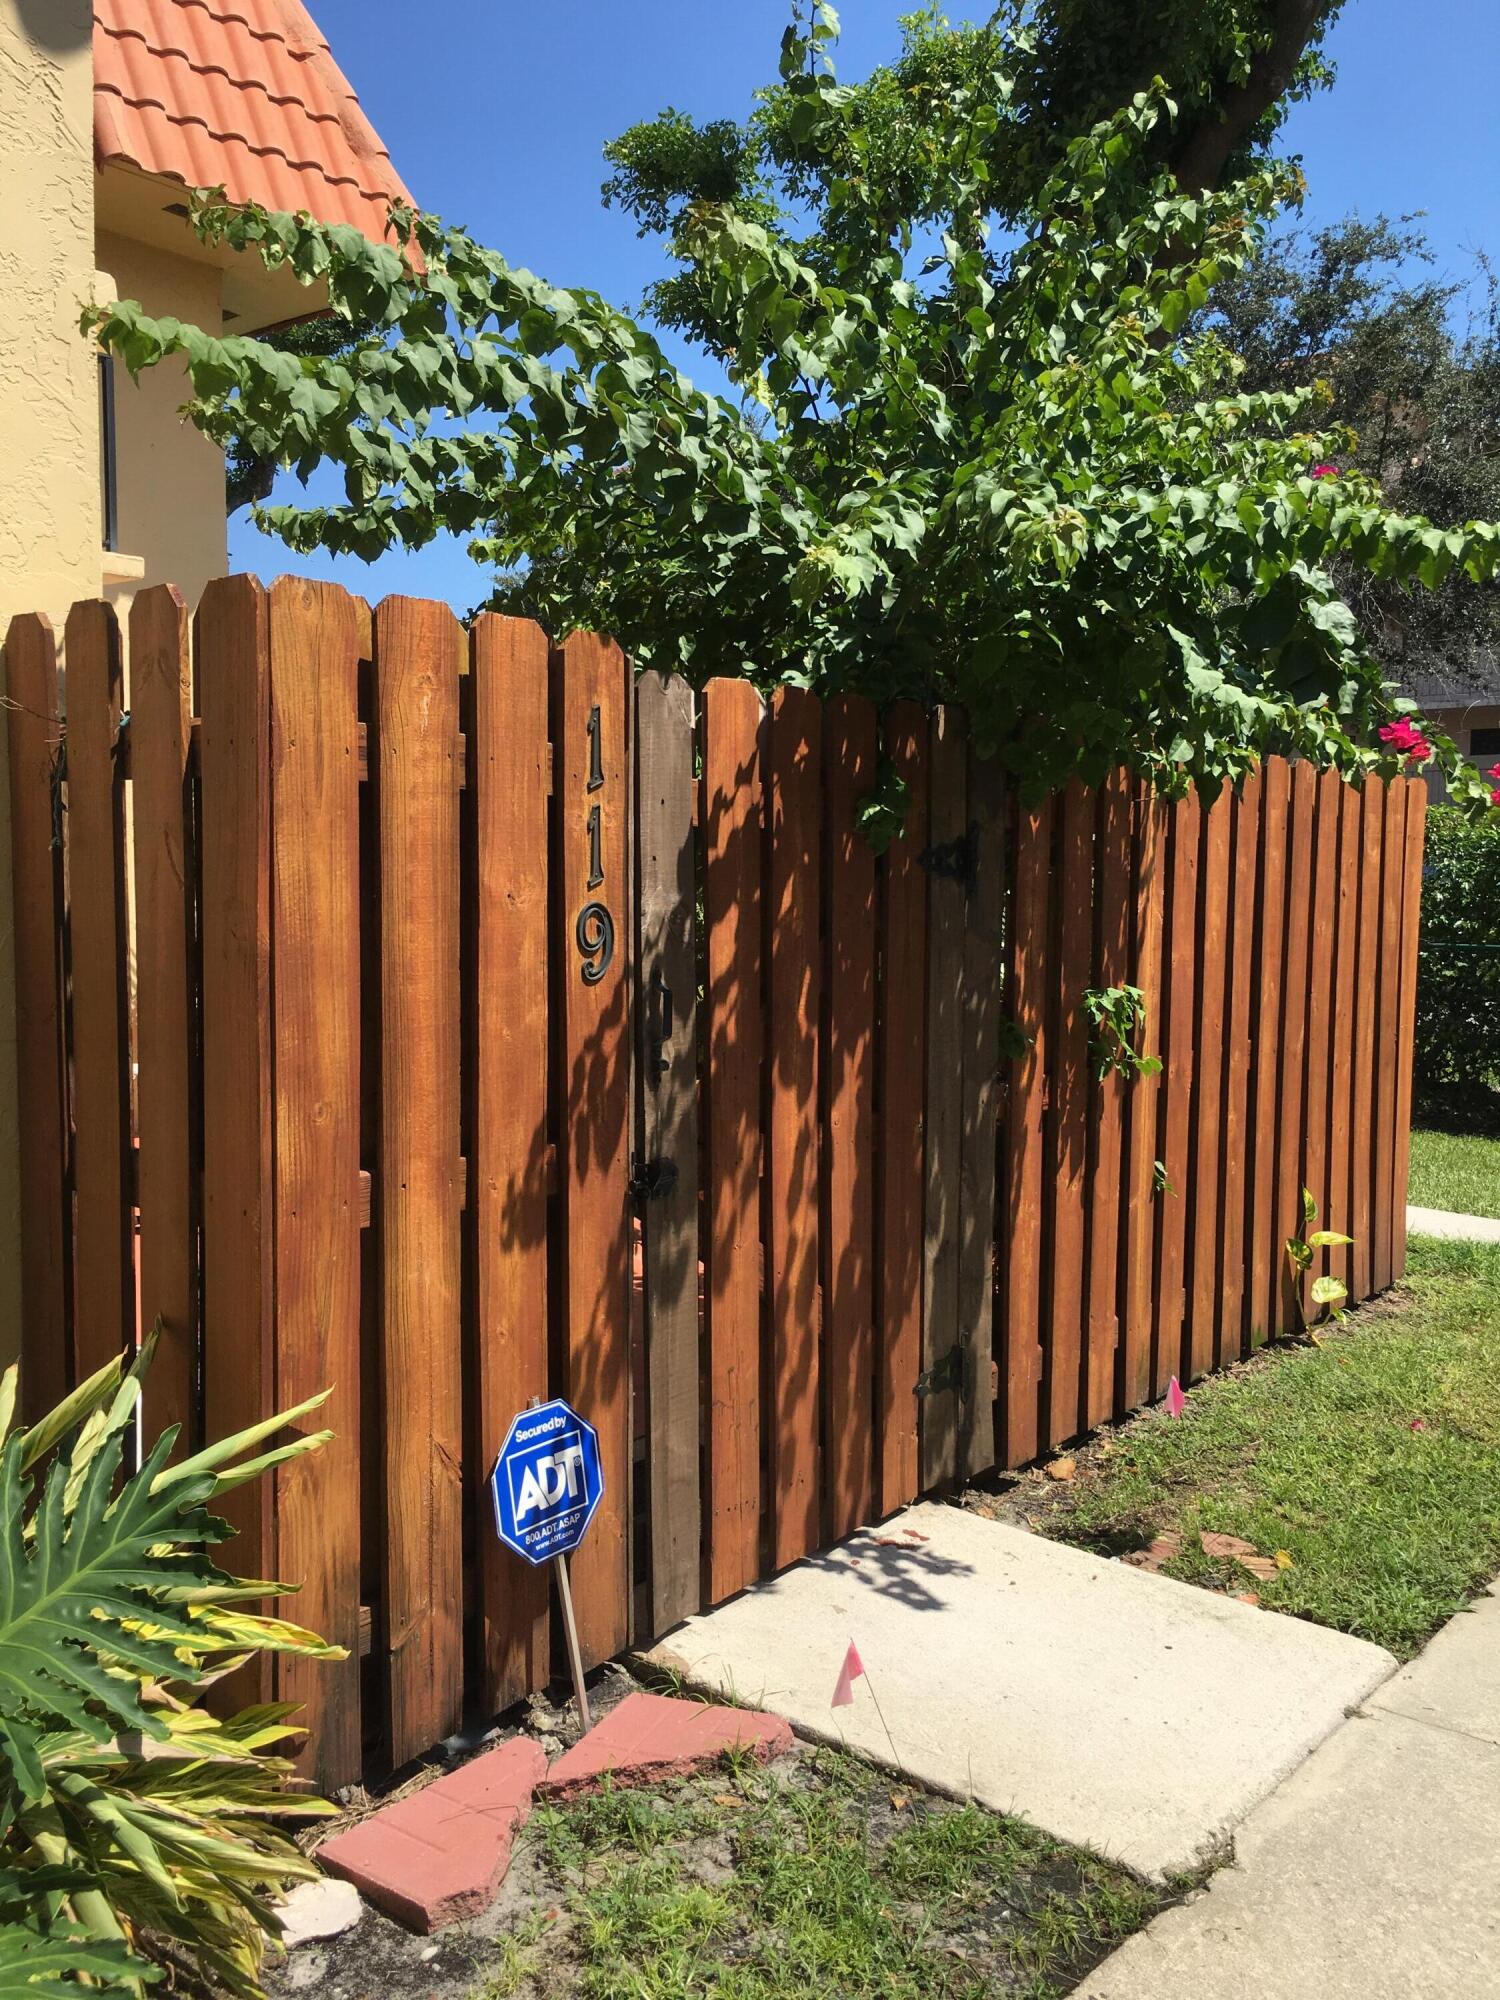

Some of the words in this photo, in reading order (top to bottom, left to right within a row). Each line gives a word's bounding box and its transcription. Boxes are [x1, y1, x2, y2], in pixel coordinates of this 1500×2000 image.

[576, 703, 615, 986] 119
[515, 1417, 554, 1443] Secured
[554, 1415, 567, 1429] by
[516, 1444, 580, 1522] ADT
[535, 1529, 575, 1551] www.ADT.com
